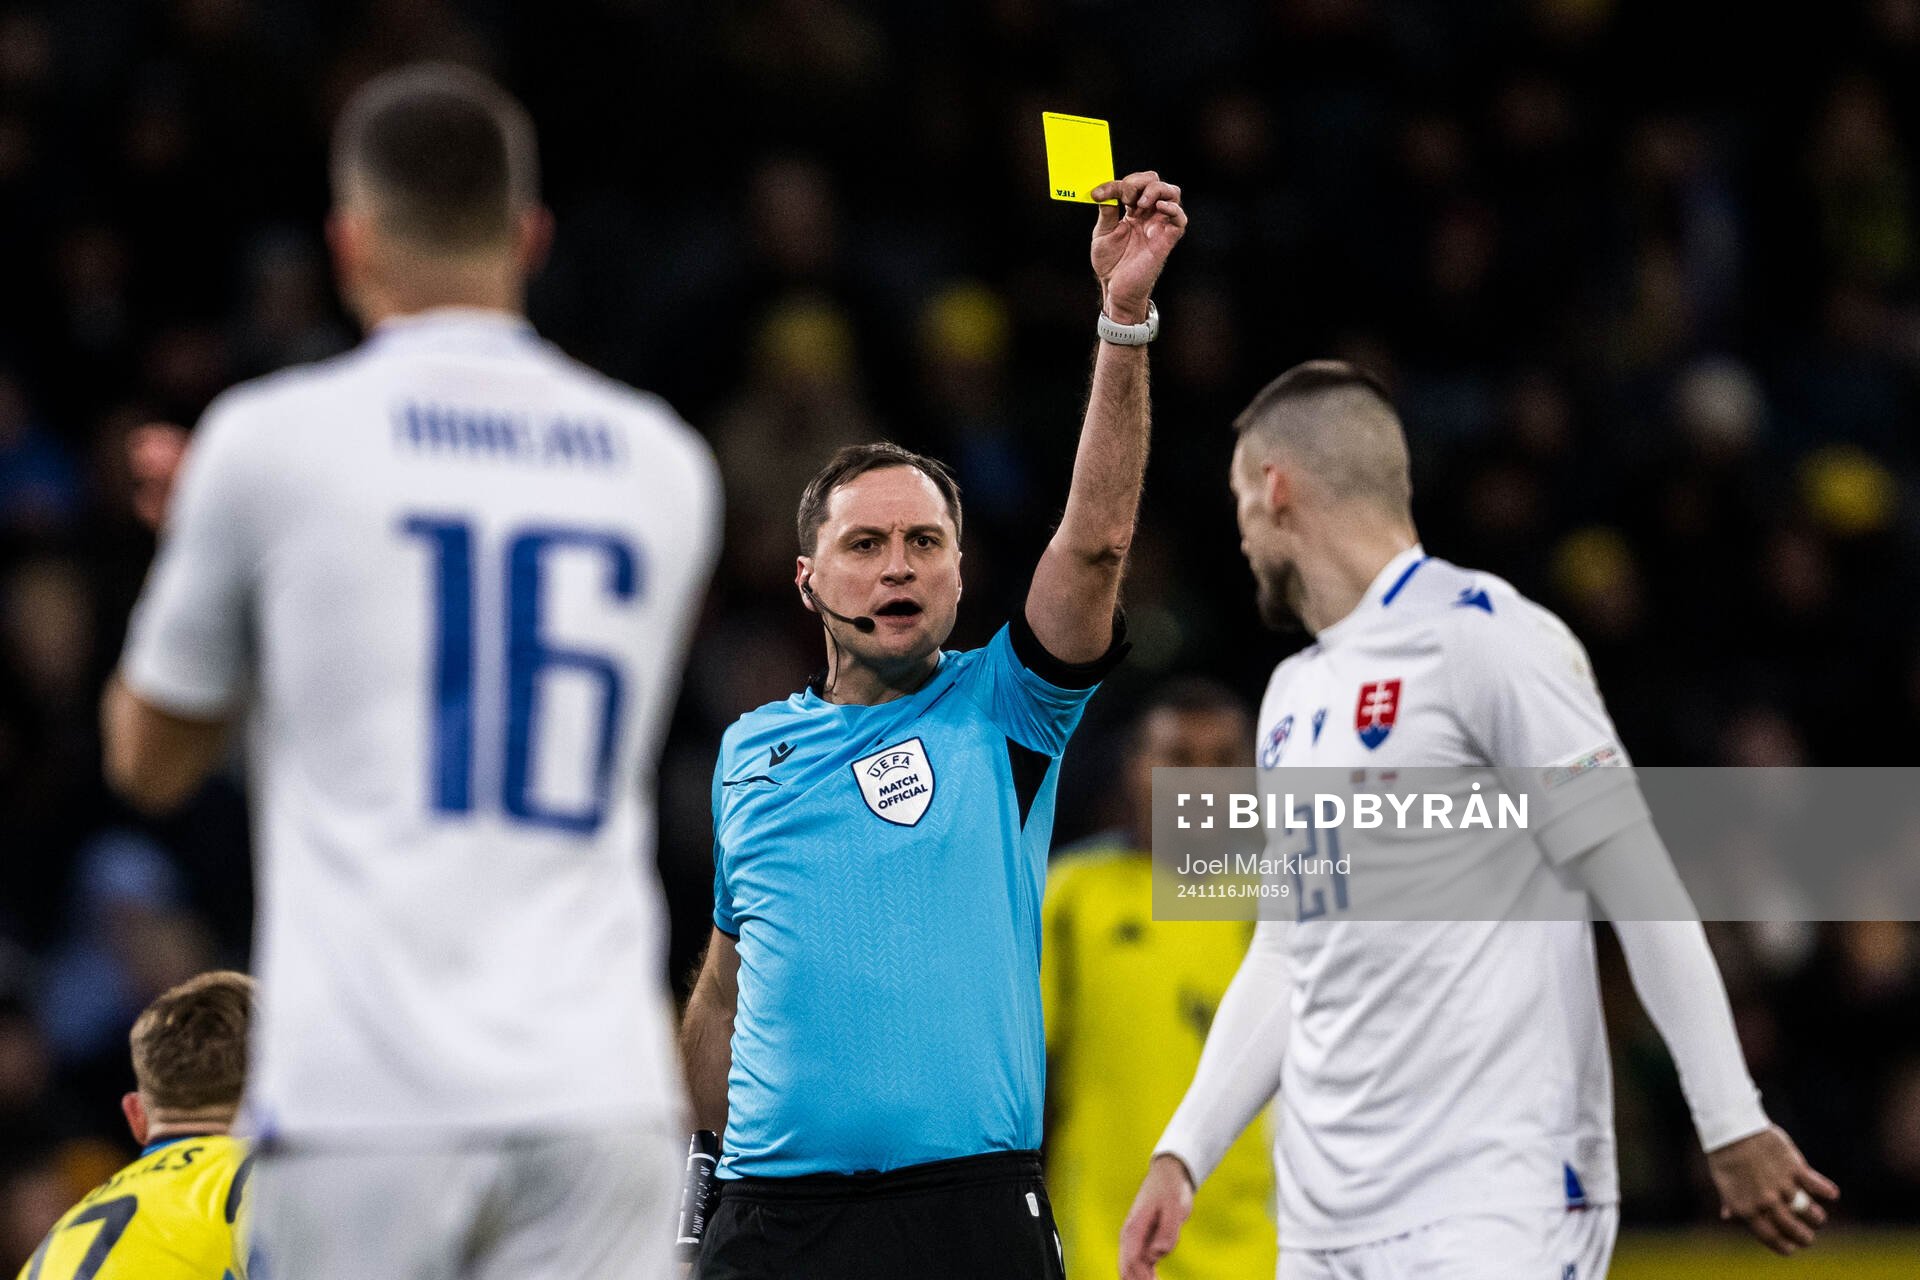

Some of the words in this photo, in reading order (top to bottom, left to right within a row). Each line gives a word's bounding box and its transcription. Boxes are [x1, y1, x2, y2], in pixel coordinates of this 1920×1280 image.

[1056, 189, 1076, 198] FIFA
[395, 512, 644, 836] 16
[870, 755, 910, 778] UEFA
[878, 784, 928, 810] OFFICIAL
[879, 773, 919, 797] MATCH
